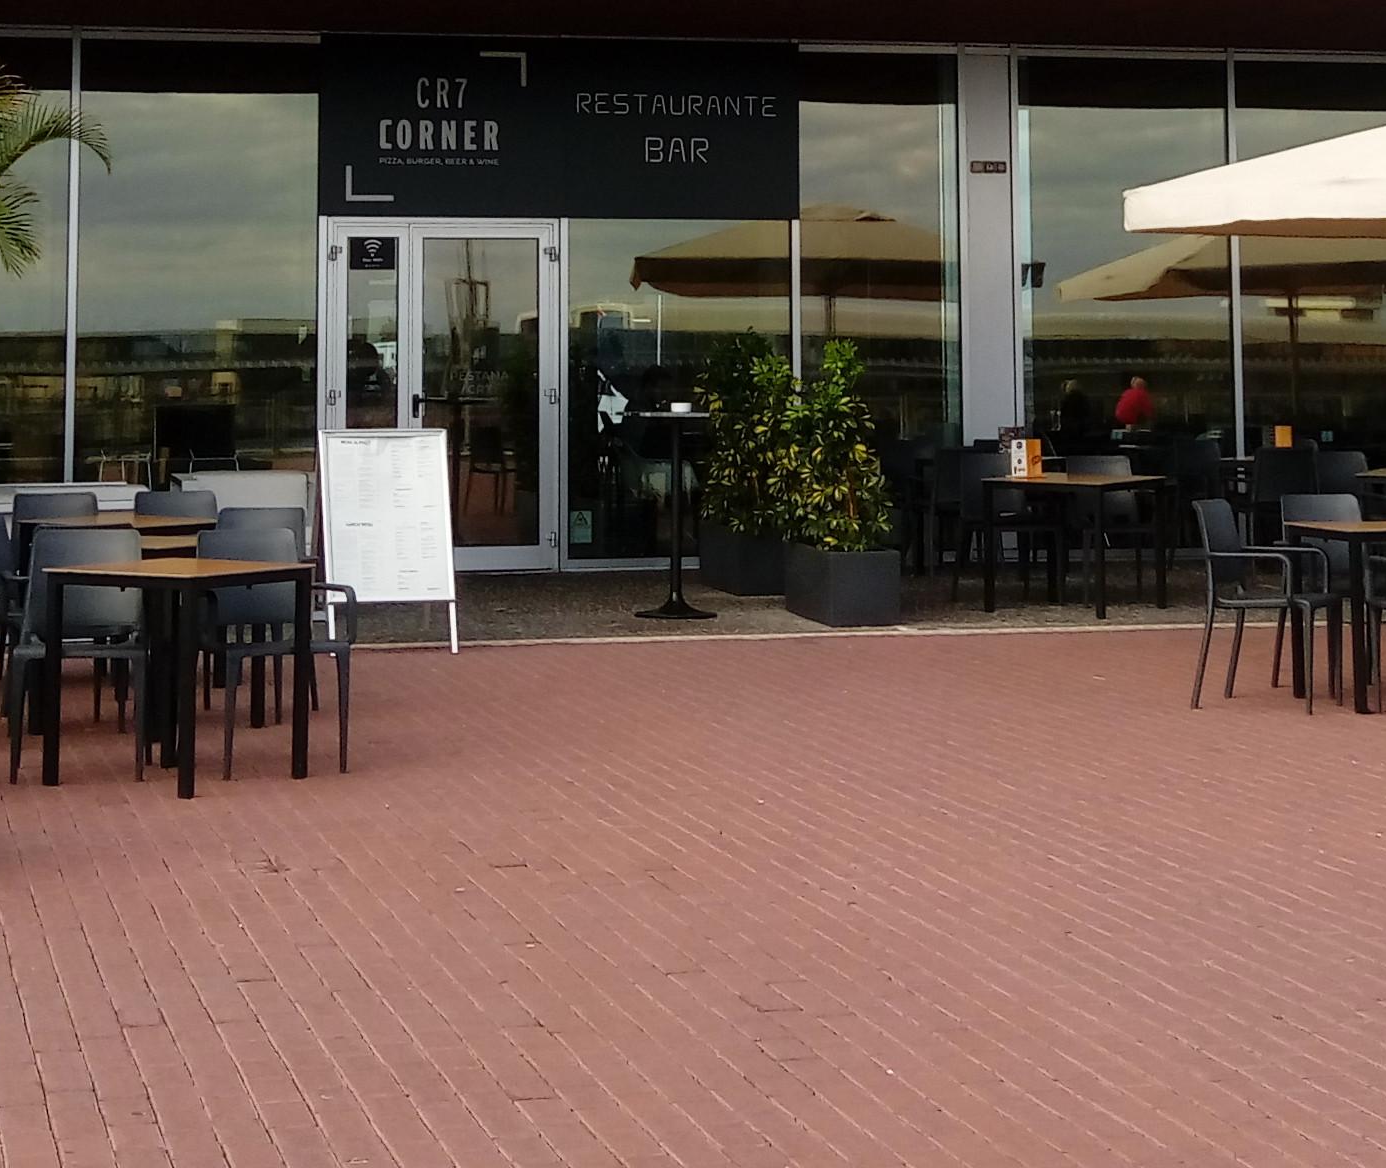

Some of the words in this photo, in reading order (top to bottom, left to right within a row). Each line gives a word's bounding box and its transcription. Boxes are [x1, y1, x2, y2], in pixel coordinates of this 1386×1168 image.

[416, 77, 468, 109] CR7
[576, 92, 777, 117] RESTAURANTE
[379, 119, 500, 151] CORNER
[379, 156, 405, 165] PIZZA,
[406, 157, 444, 166] BURGER,
[445, 157, 468, 165] BEER
[476, 157, 500, 166] WINE
[644, 136, 709, 164] BAR
